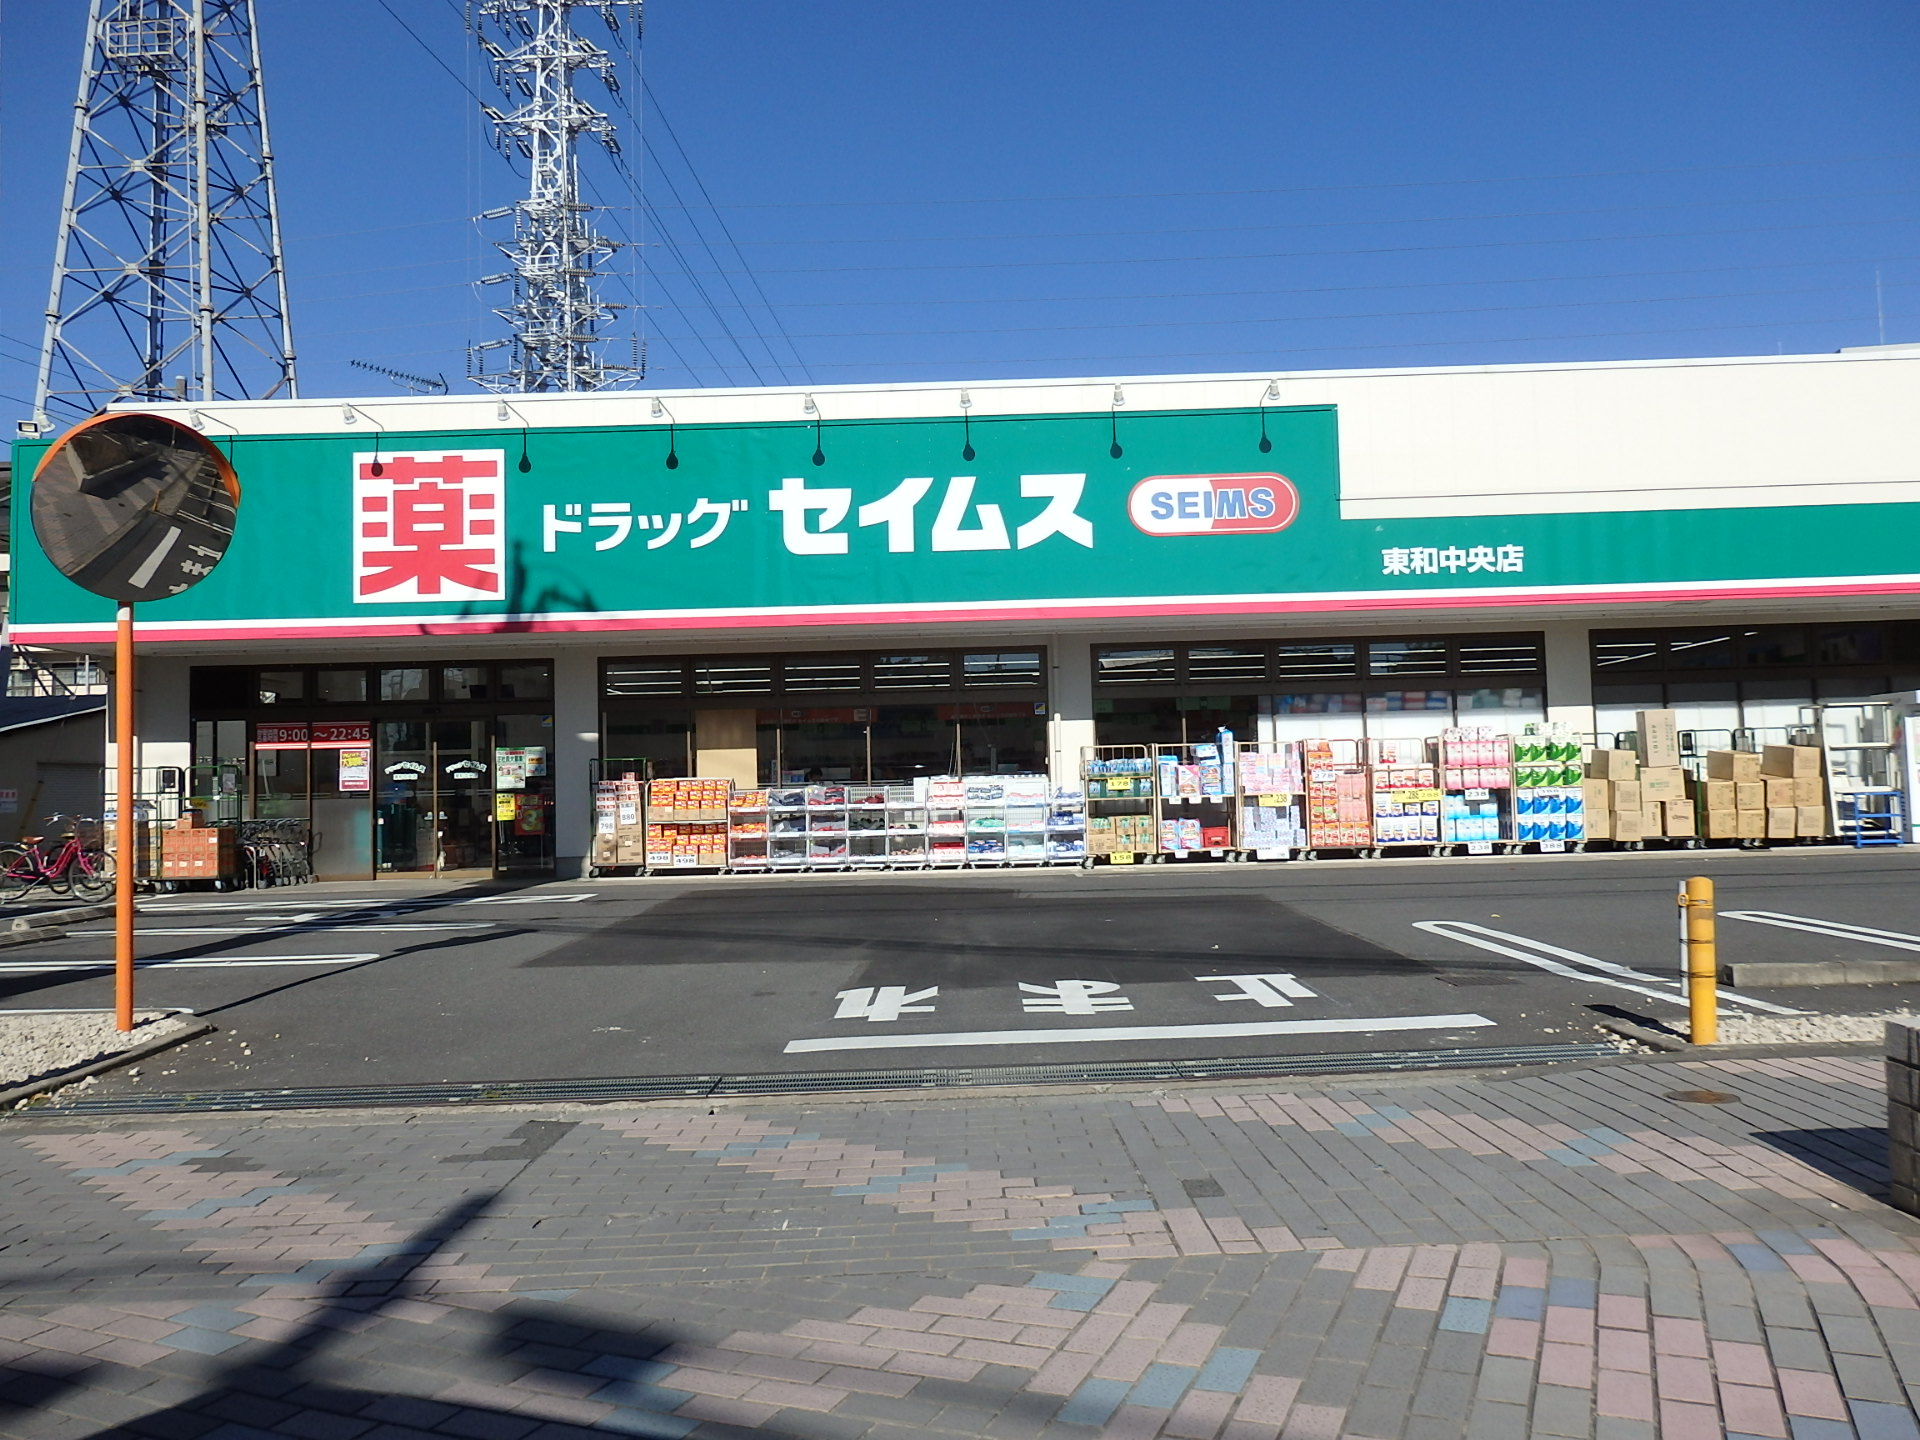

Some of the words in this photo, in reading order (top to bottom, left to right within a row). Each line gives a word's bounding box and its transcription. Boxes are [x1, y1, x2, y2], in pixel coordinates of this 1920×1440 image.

[542, 498, 748, 553] ドラッグ
[769, 473, 1094, 556] セイムス
[1151, 487, 1276, 520] SEIMS
[358, 454, 500, 595] 薬
[1381, 544, 1524, 575] 東和中央店
[279, 729, 309, 741] 9:00
[833, 974, 1318, 1022] 止まれ
